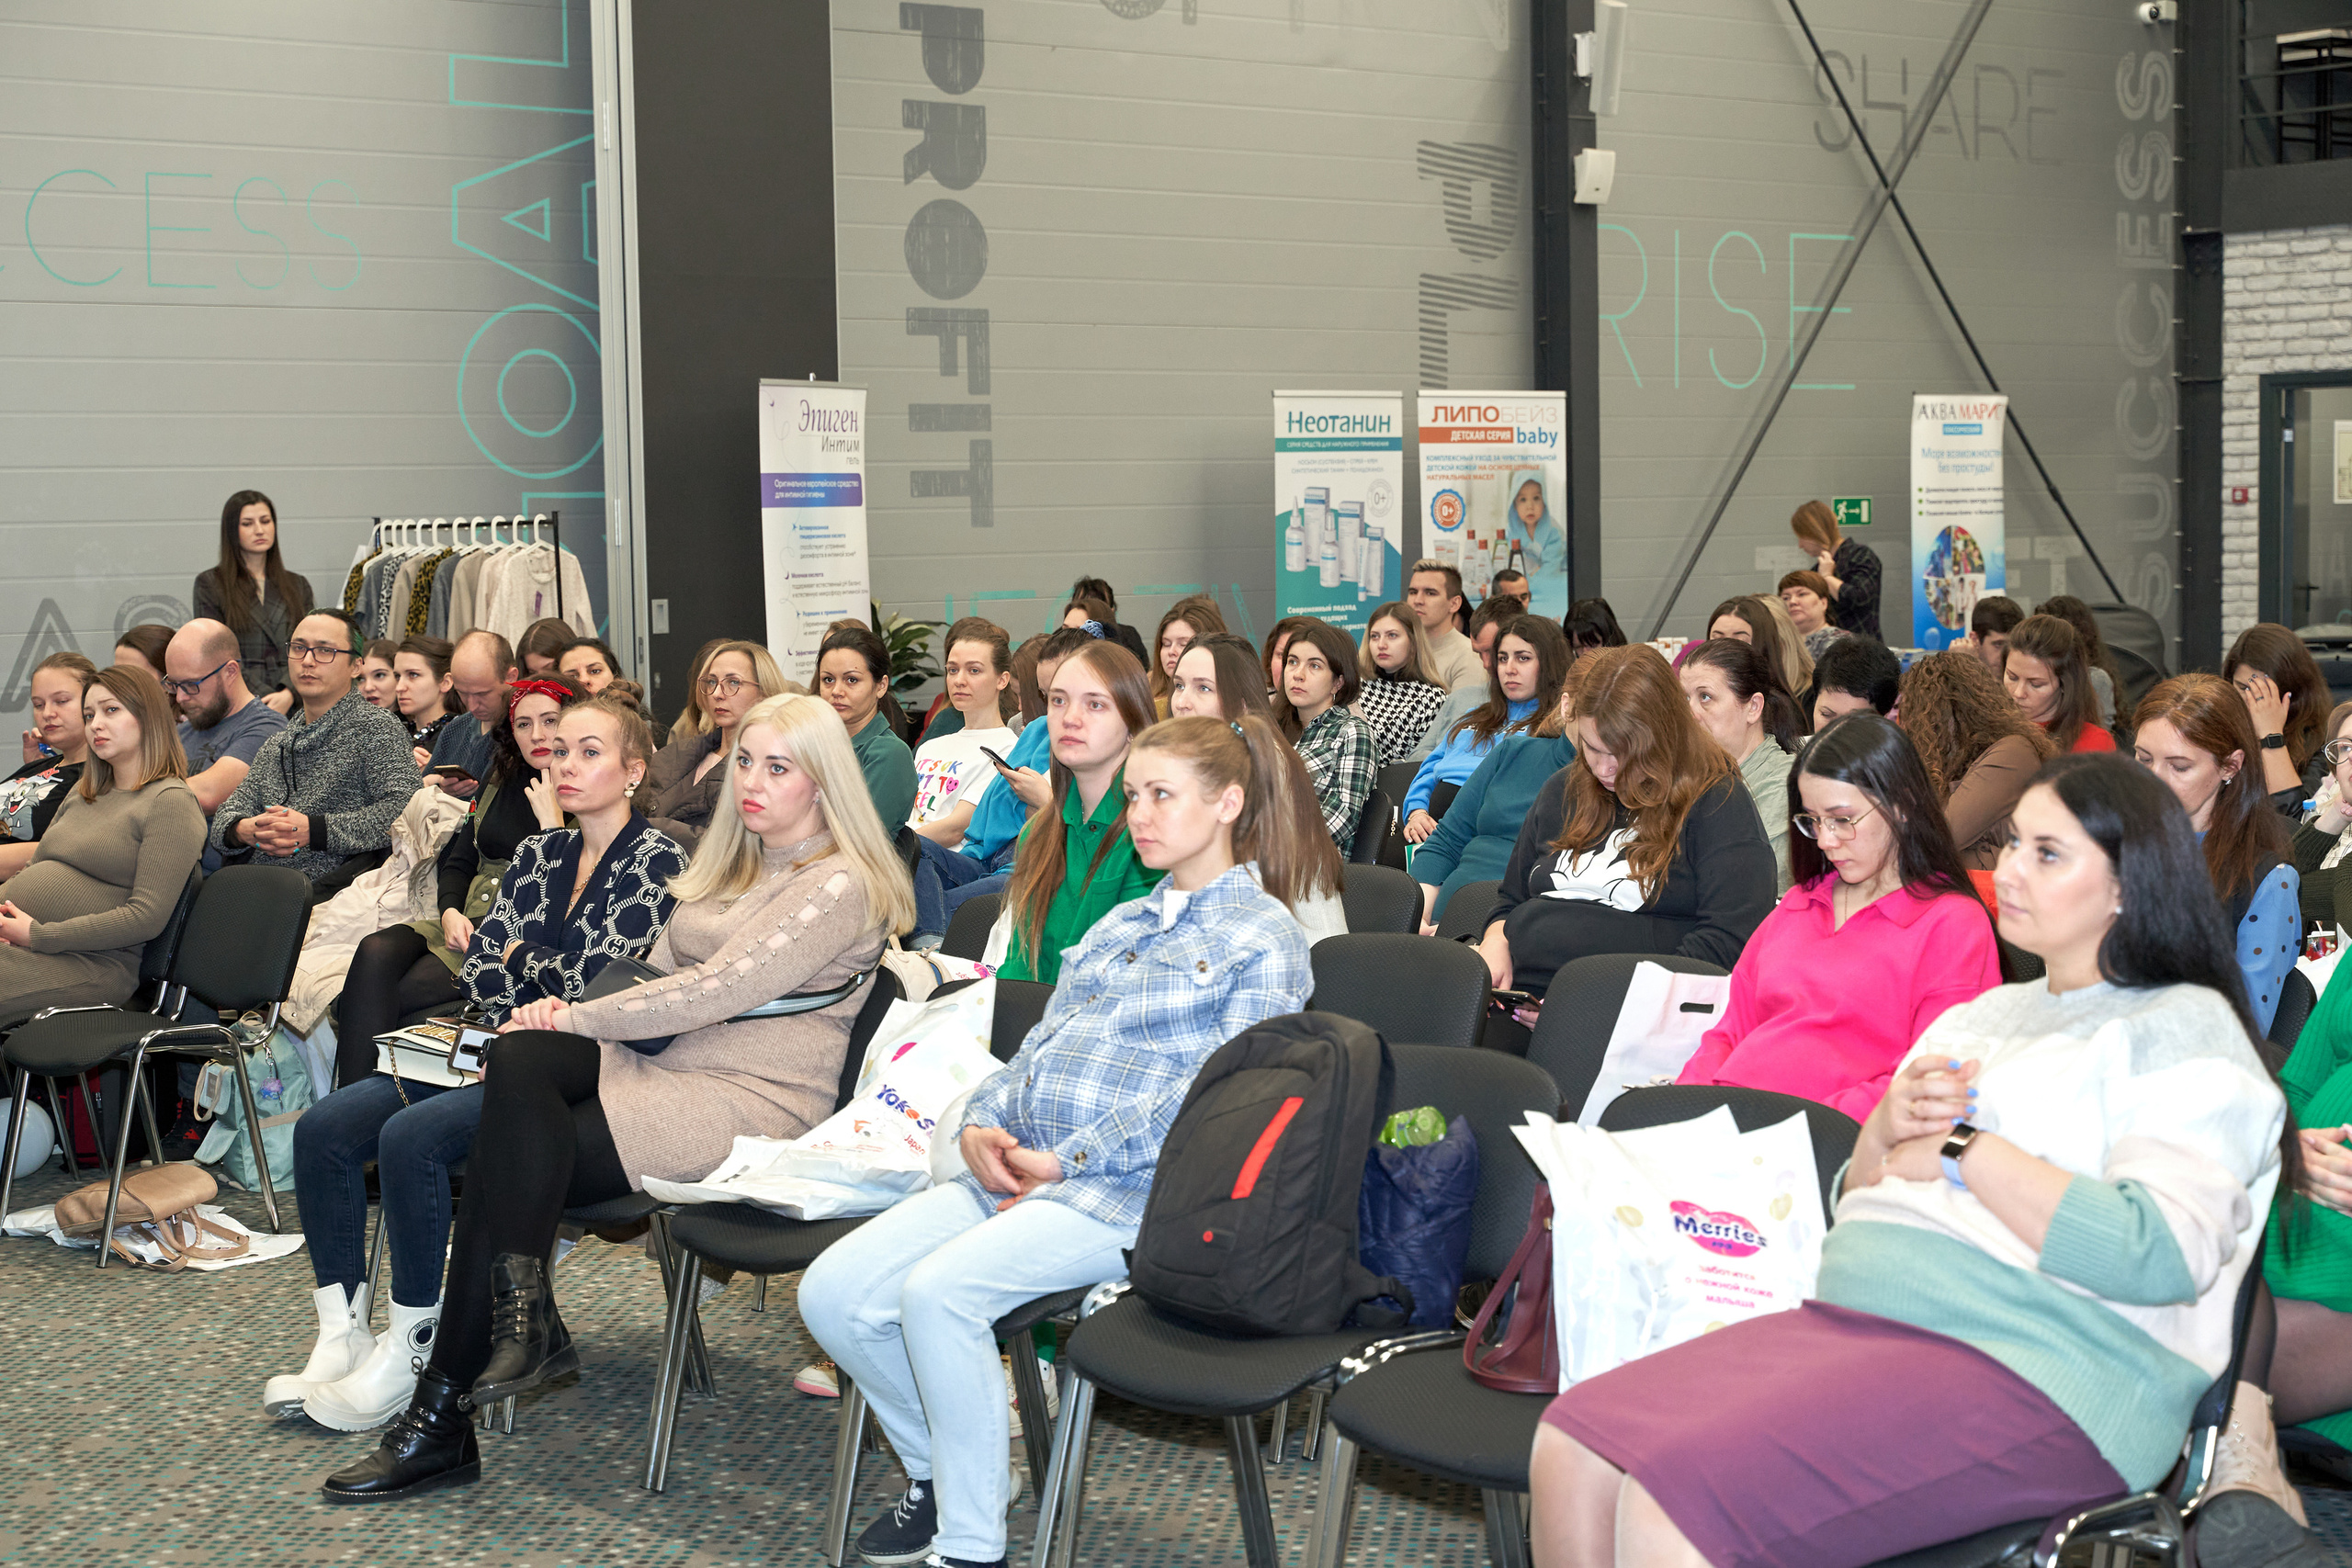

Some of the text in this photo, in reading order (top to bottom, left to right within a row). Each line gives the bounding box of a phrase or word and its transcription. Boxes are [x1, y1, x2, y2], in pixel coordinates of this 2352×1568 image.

[1813, 48, 2065, 166] SHARE
[0, 169, 362, 291] CESS
[899, 2, 995, 529] PROFIT
[1597, 224, 1857, 390] RISE
[2115, 50, 2177, 622] SUCCESS
[798, 399, 858, 433] Эпиген
[1286, 411, 1391, 434] Неотанин
[1431, 405, 1558, 423] ЛИПОБЕЙЗ
[821, 435, 860, 453] Интим
[1451, 430, 1511, 442] ДЕТСКАЯ СЕРИЯ
[1517, 427, 1558, 448] baby
[1442, 504, 1454, 517] 0+
[941, 761, 963, 775] OK
[904, 1134, 926, 1156] Japan
[1674, 1214, 1768, 1248] Merries
[1706, 1294, 1756, 1309] малыша
[1744, 1286, 1774, 1299] коже
